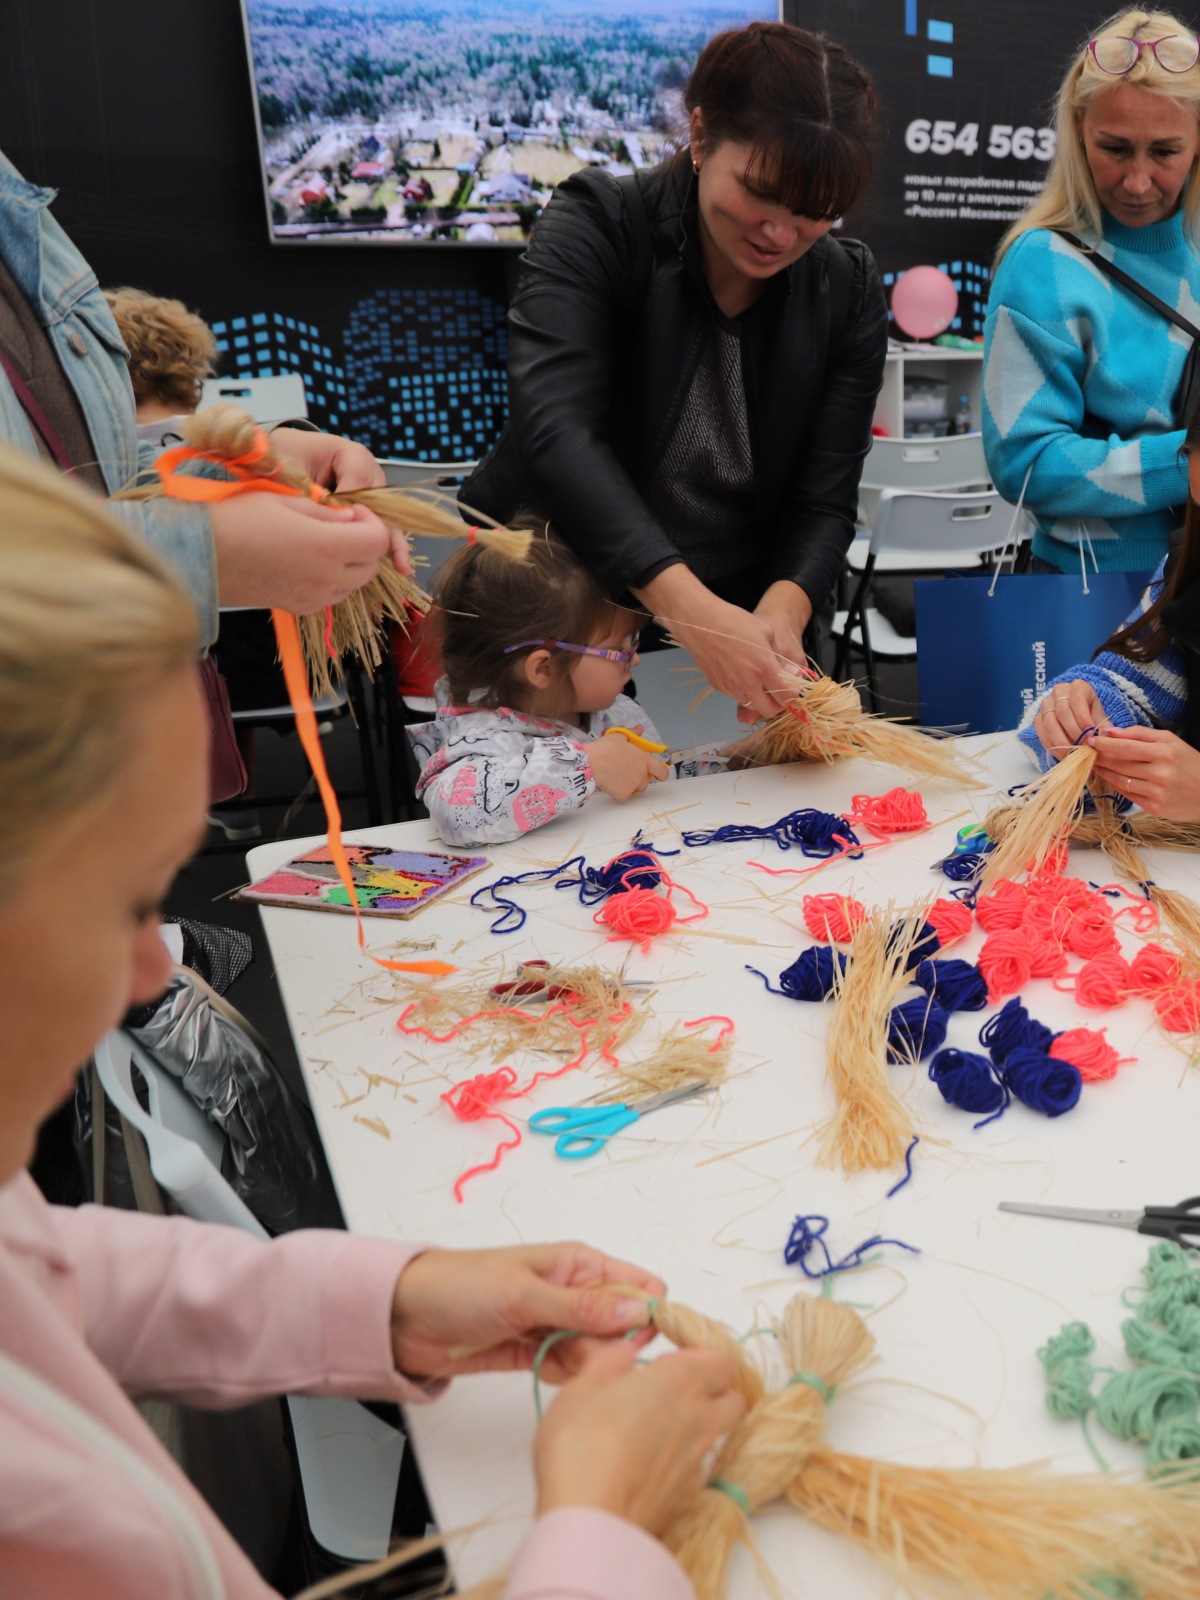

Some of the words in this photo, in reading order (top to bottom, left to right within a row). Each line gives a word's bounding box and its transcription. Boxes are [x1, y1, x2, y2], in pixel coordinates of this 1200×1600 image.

[905, 119, 979, 156] 654
[987, 124, 1056, 161] 563
[904, 174, 942, 187] новых
